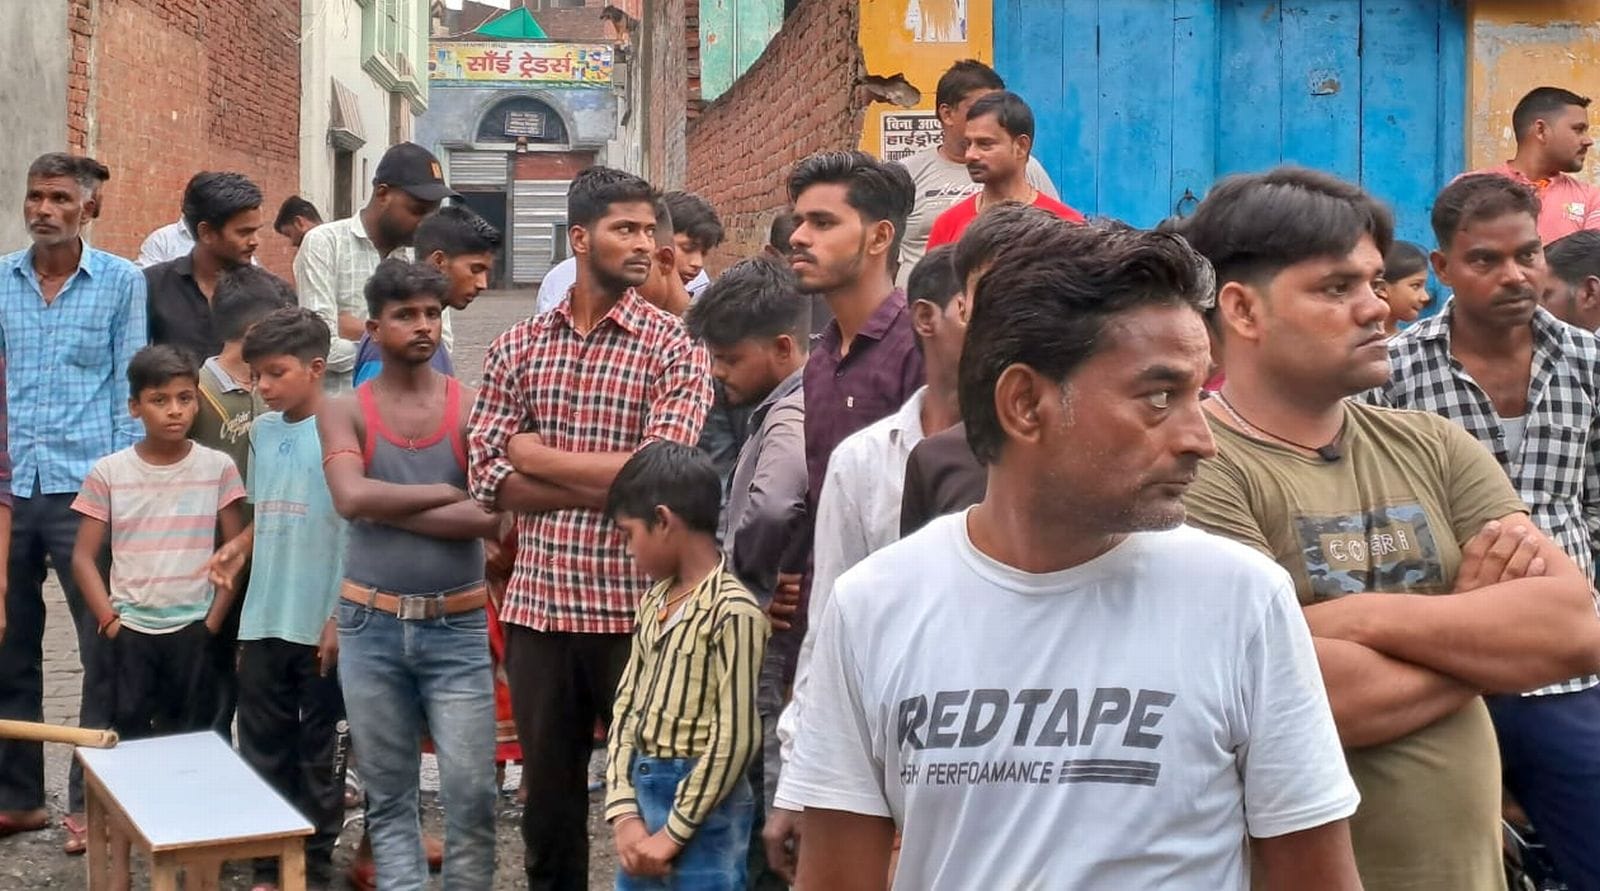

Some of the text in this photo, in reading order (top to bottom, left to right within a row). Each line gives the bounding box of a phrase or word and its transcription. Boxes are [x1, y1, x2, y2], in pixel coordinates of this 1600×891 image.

[518, 51, 573, 78] ट्रेडर्स
[918, 118, 943, 130] आप
[897, 687, 1177, 751] REDTAPE
